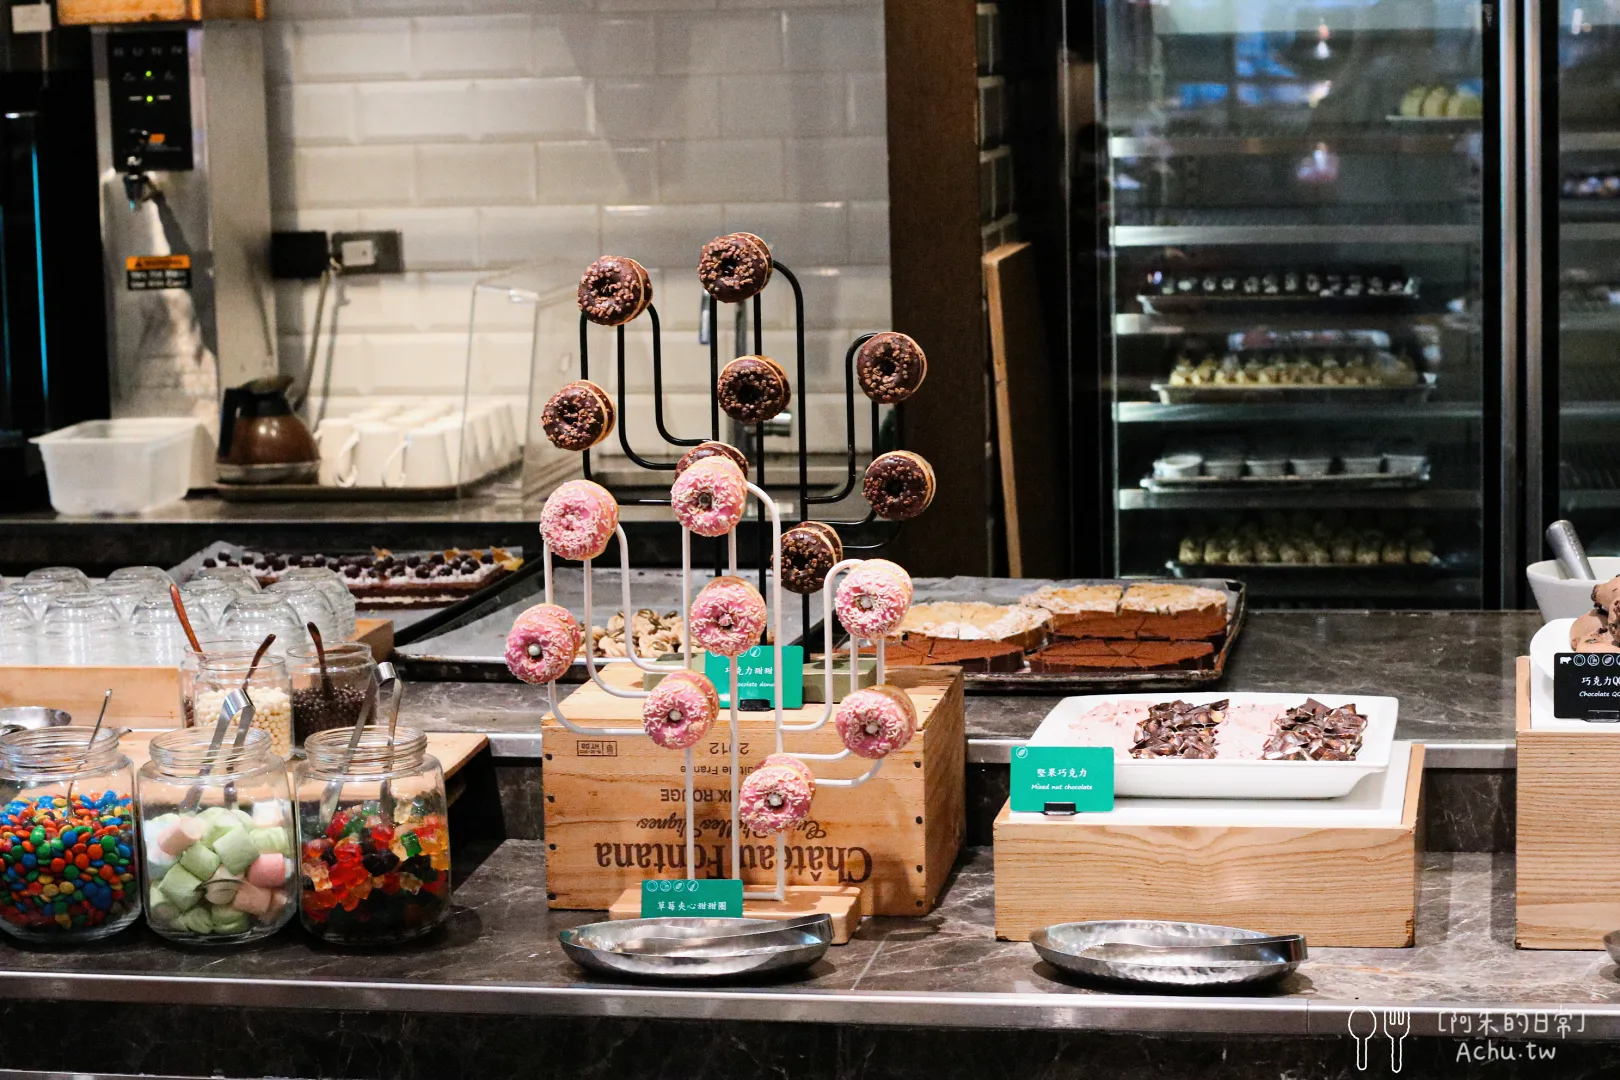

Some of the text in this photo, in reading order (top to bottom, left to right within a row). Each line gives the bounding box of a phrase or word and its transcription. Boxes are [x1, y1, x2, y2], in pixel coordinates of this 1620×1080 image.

[725, 666, 774, 676] 巧克力甜甜
[709, 742, 750, 755] 212
[680, 765, 718, 775] Frane
[1037, 768, 1087, 778] 堅果巧克力
